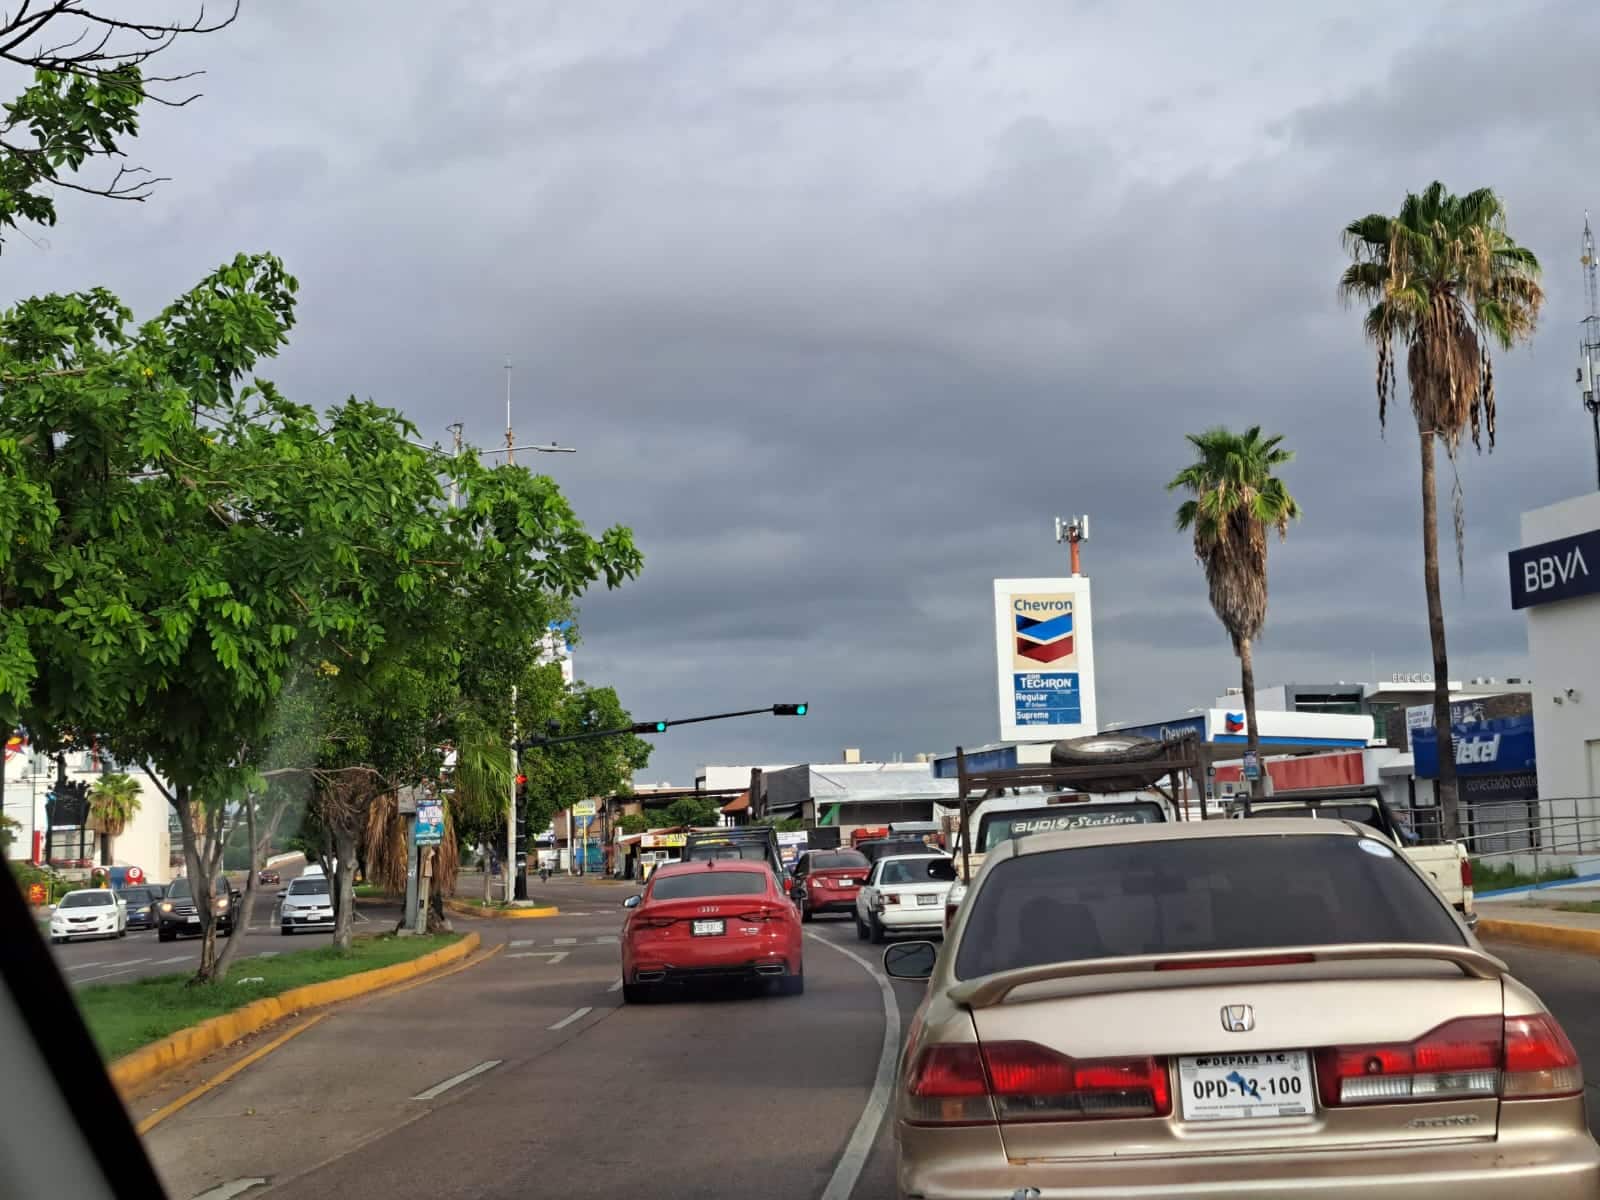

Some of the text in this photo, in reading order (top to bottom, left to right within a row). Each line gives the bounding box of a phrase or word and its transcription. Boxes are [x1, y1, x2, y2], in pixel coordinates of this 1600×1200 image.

[1523, 545, 1590, 593] BBVA
[1014, 599, 1073, 612] Chevron
[1020, 678, 1073, 690] TECHRON
[1016, 692, 1048, 702] Regular
[1016, 711, 1049, 721] Supreme
[1455, 733, 1502, 766] telcel
[1193, 1076, 1302, 1100] OPD-12-100
